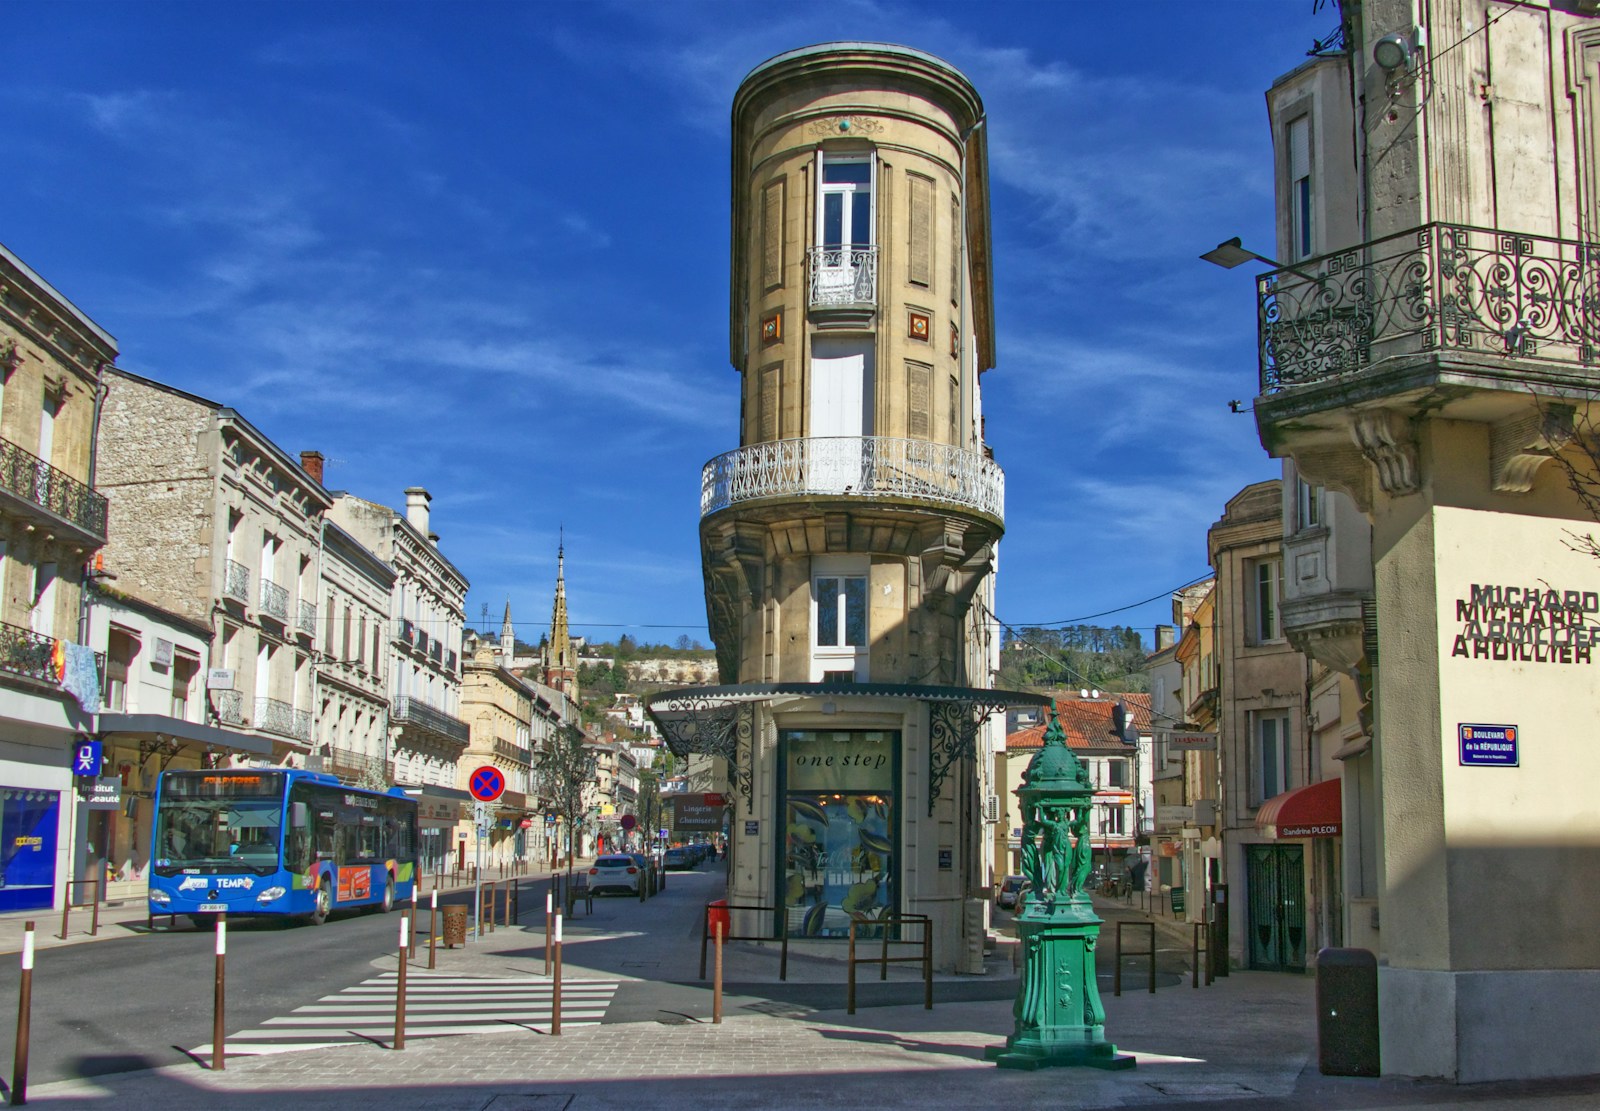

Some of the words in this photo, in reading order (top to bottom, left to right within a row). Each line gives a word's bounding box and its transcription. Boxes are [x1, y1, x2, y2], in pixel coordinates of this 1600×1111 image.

[1470, 583, 1599, 613] MICHARD
[1473, 731, 1505, 739] BOULEVARD
[1465, 742, 1473, 750] de
[1480, 742, 1513, 751] RÉPUBLIQUE
[796, 754, 834, 767] one
[842, 753, 887, 770] step
[82, 784, 114, 793] Institut
[683, 804, 712, 815] Lingerie
[679, 816, 717, 824] Chemiserie
[1283, 826, 1312, 836] Sandrine
[1311, 826, 1337, 834] PLEON
